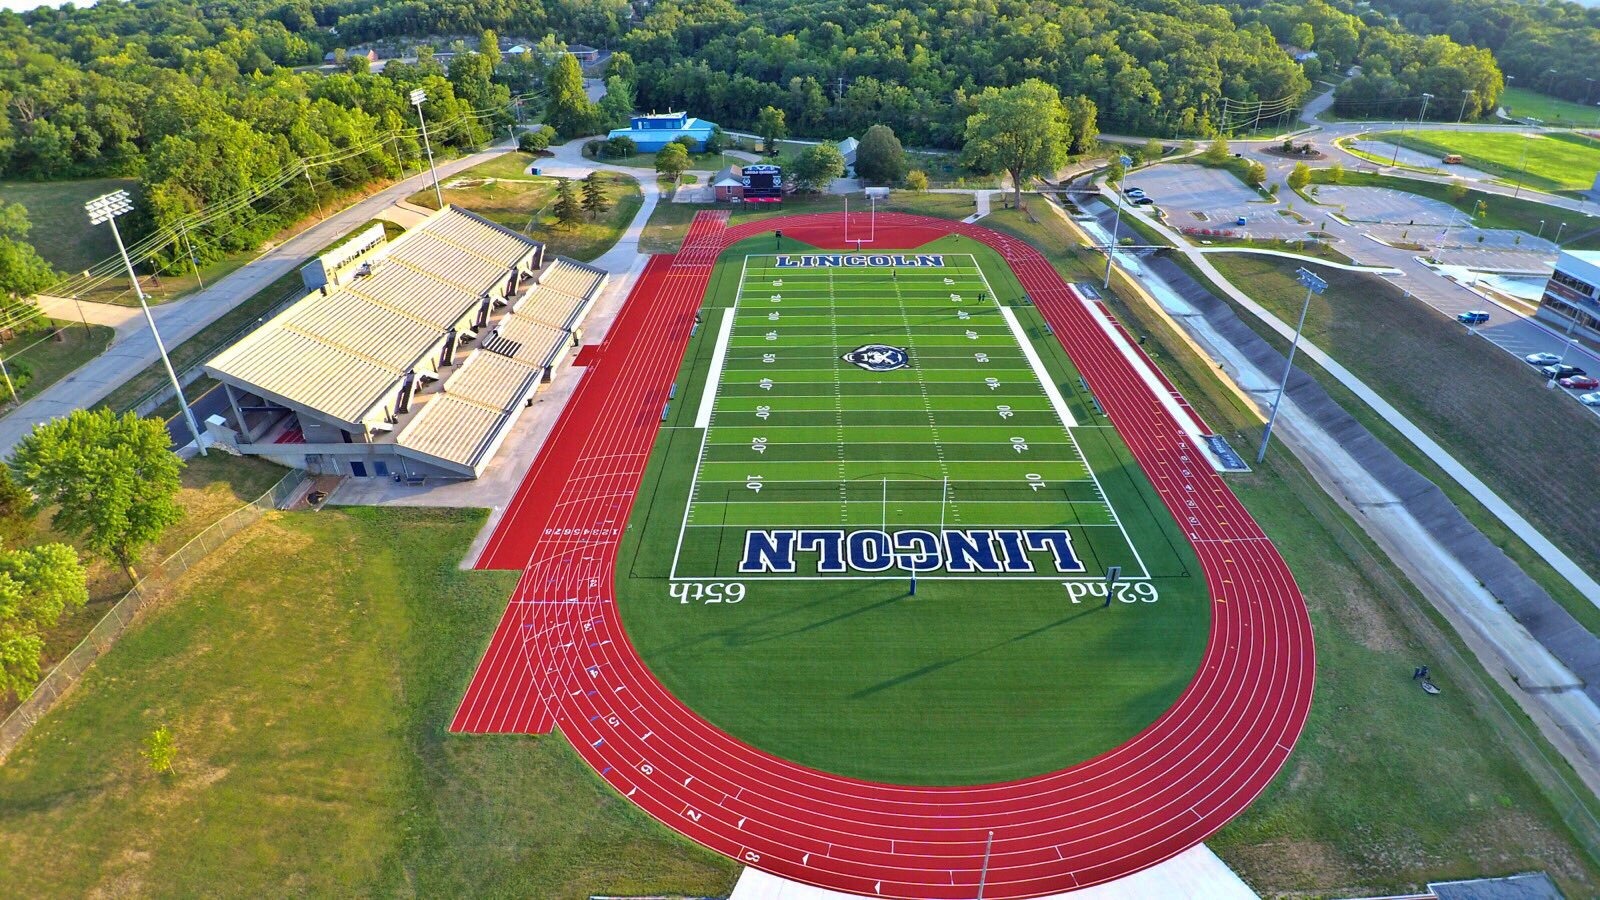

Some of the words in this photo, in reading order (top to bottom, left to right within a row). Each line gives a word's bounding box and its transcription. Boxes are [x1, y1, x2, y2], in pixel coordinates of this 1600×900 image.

[775, 255, 945, 268] LINCOLN
[762, 353, 776, 363] 50
[974, 352, 990, 362] 50
[760, 378, 773, 388] 40
[984, 378, 1000, 388] 40
[756, 406, 770, 417] 30
[996, 405, 1014, 417] 30
[752, 437, 768, 451] 20
[1010, 436, 1029, 451] 20
[746, 475, 763, 489] 10
[1025, 473, 1046, 488] 10
[738, 529, 1087, 573] LINCOLN
[669, 582, 746, 604] 65th
[1061, 582, 1159, 604] 62nd
[589, 669, 599, 679] 4
[608, 716, 620, 728] 5
[640, 764, 654, 776] 6
[686, 808, 702, 822] 7
[745, 851, 760, 863] 8
